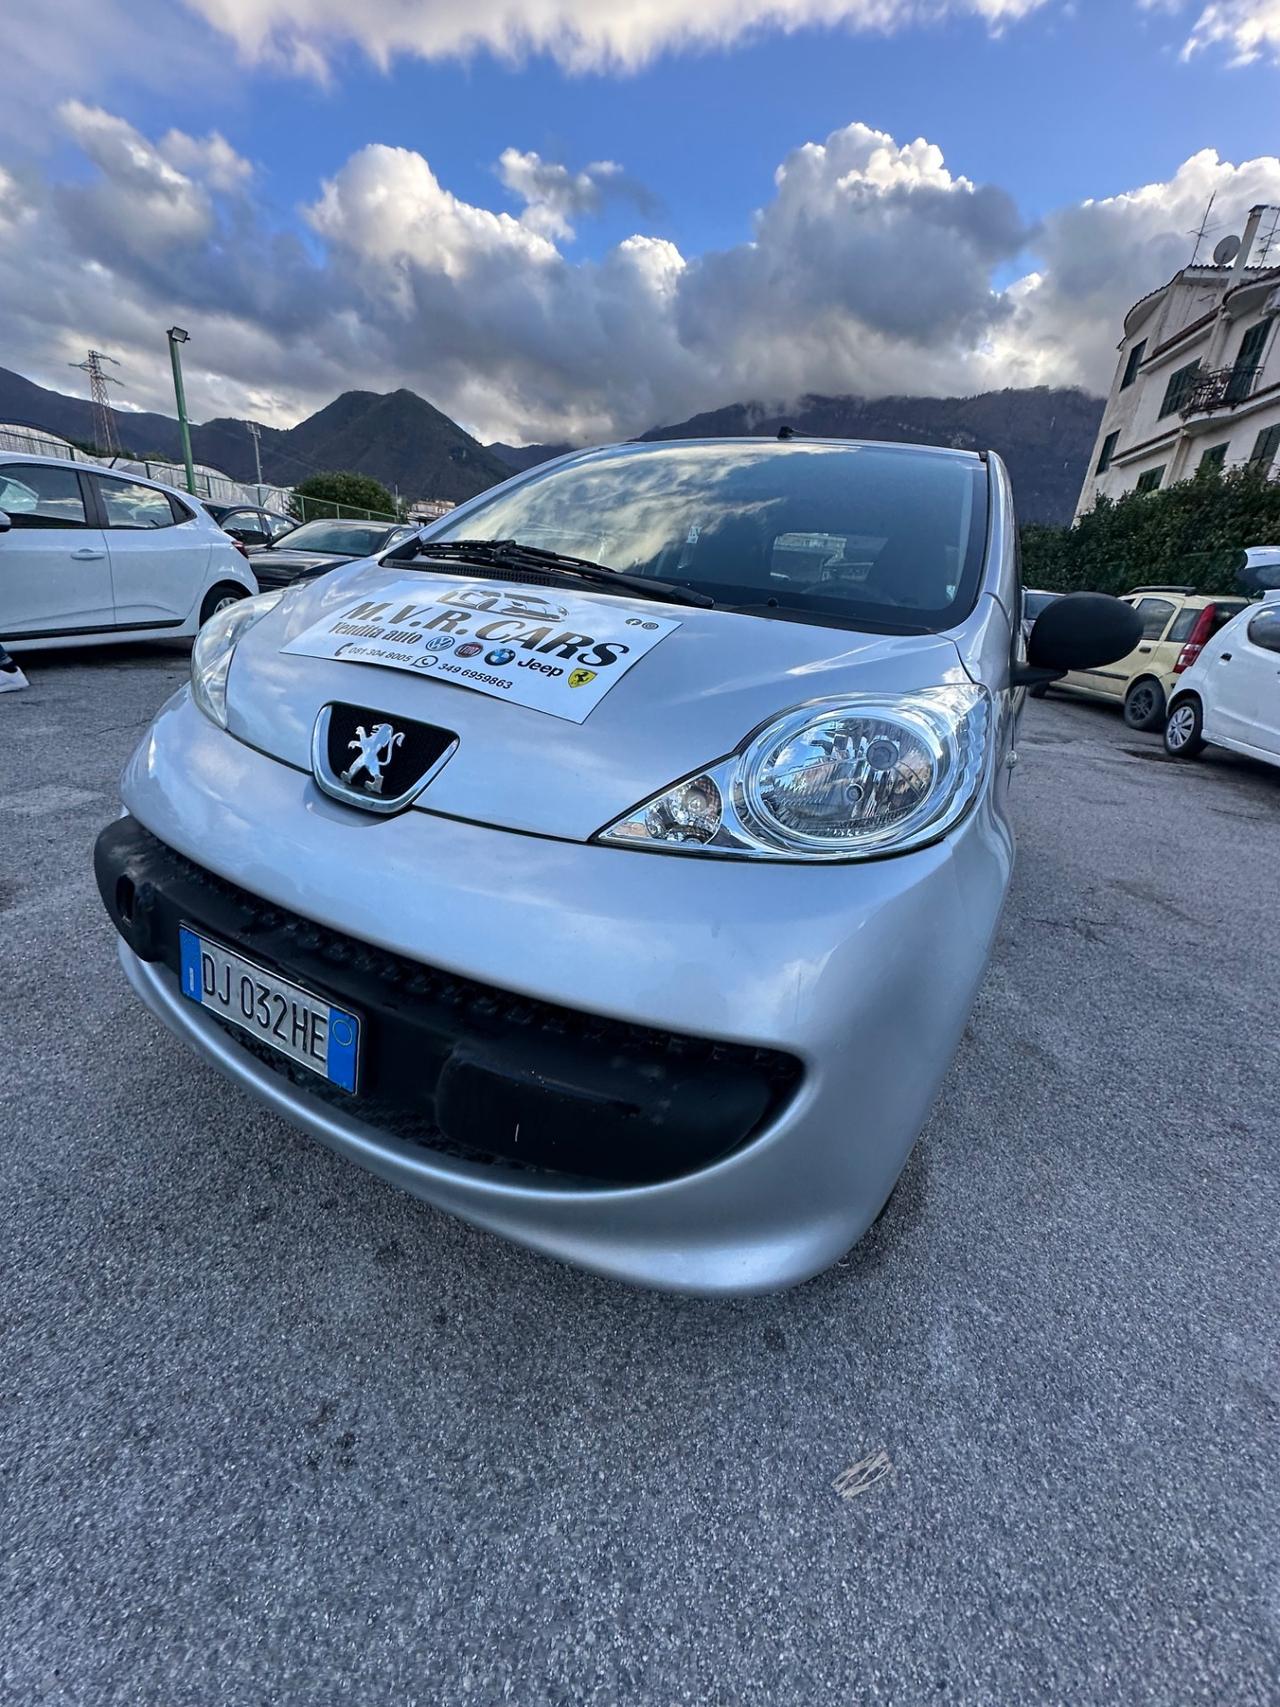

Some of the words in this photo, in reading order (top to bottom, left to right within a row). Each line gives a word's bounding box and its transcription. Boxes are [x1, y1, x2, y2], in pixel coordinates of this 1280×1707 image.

[329, 622, 386, 639] Vendita
[381, 630, 423, 645] auto
[348, 646, 366, 655] 081
[366, 648, 385, 657] 304
[385, 652, 413, 662] 8005
[438, 663, 461, 674] 349
[461, 669, 514, 690] 6959863
[517, 657, 564, 678] Jeep
